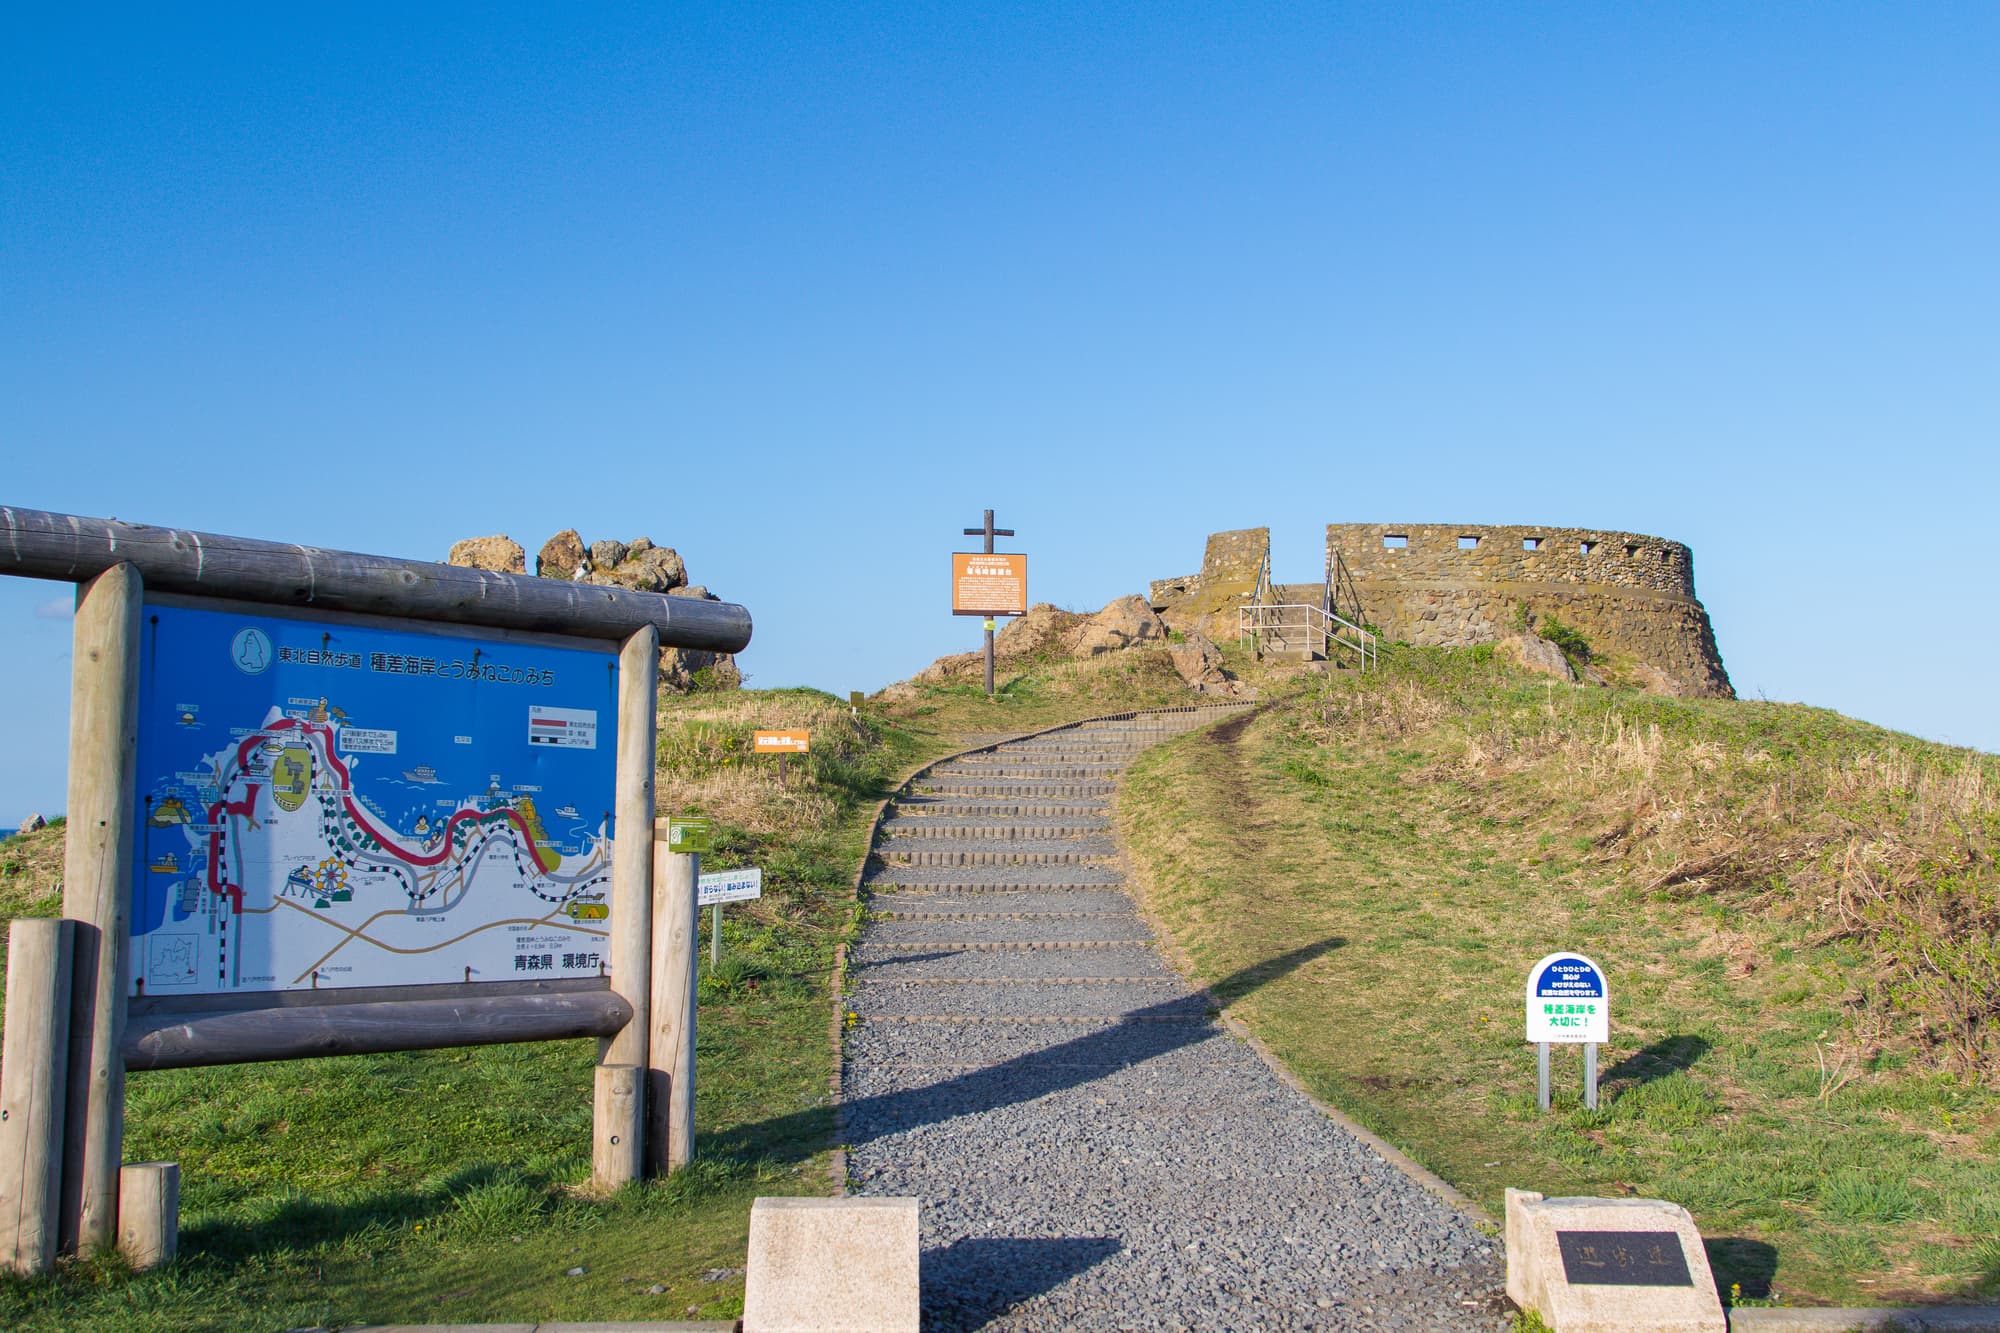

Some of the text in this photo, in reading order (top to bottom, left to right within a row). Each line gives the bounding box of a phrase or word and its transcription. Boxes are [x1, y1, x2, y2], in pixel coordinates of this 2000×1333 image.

[278, 646, 555, 686] 東北自然歩道 種差海岸とうみねこのみち
[514, 952, 600, 971] 青森県 環境庁
[1544, 1004, 1596, 1014] 種差海岸を
[1549, 1017, 1588, 1026] 大切に！
